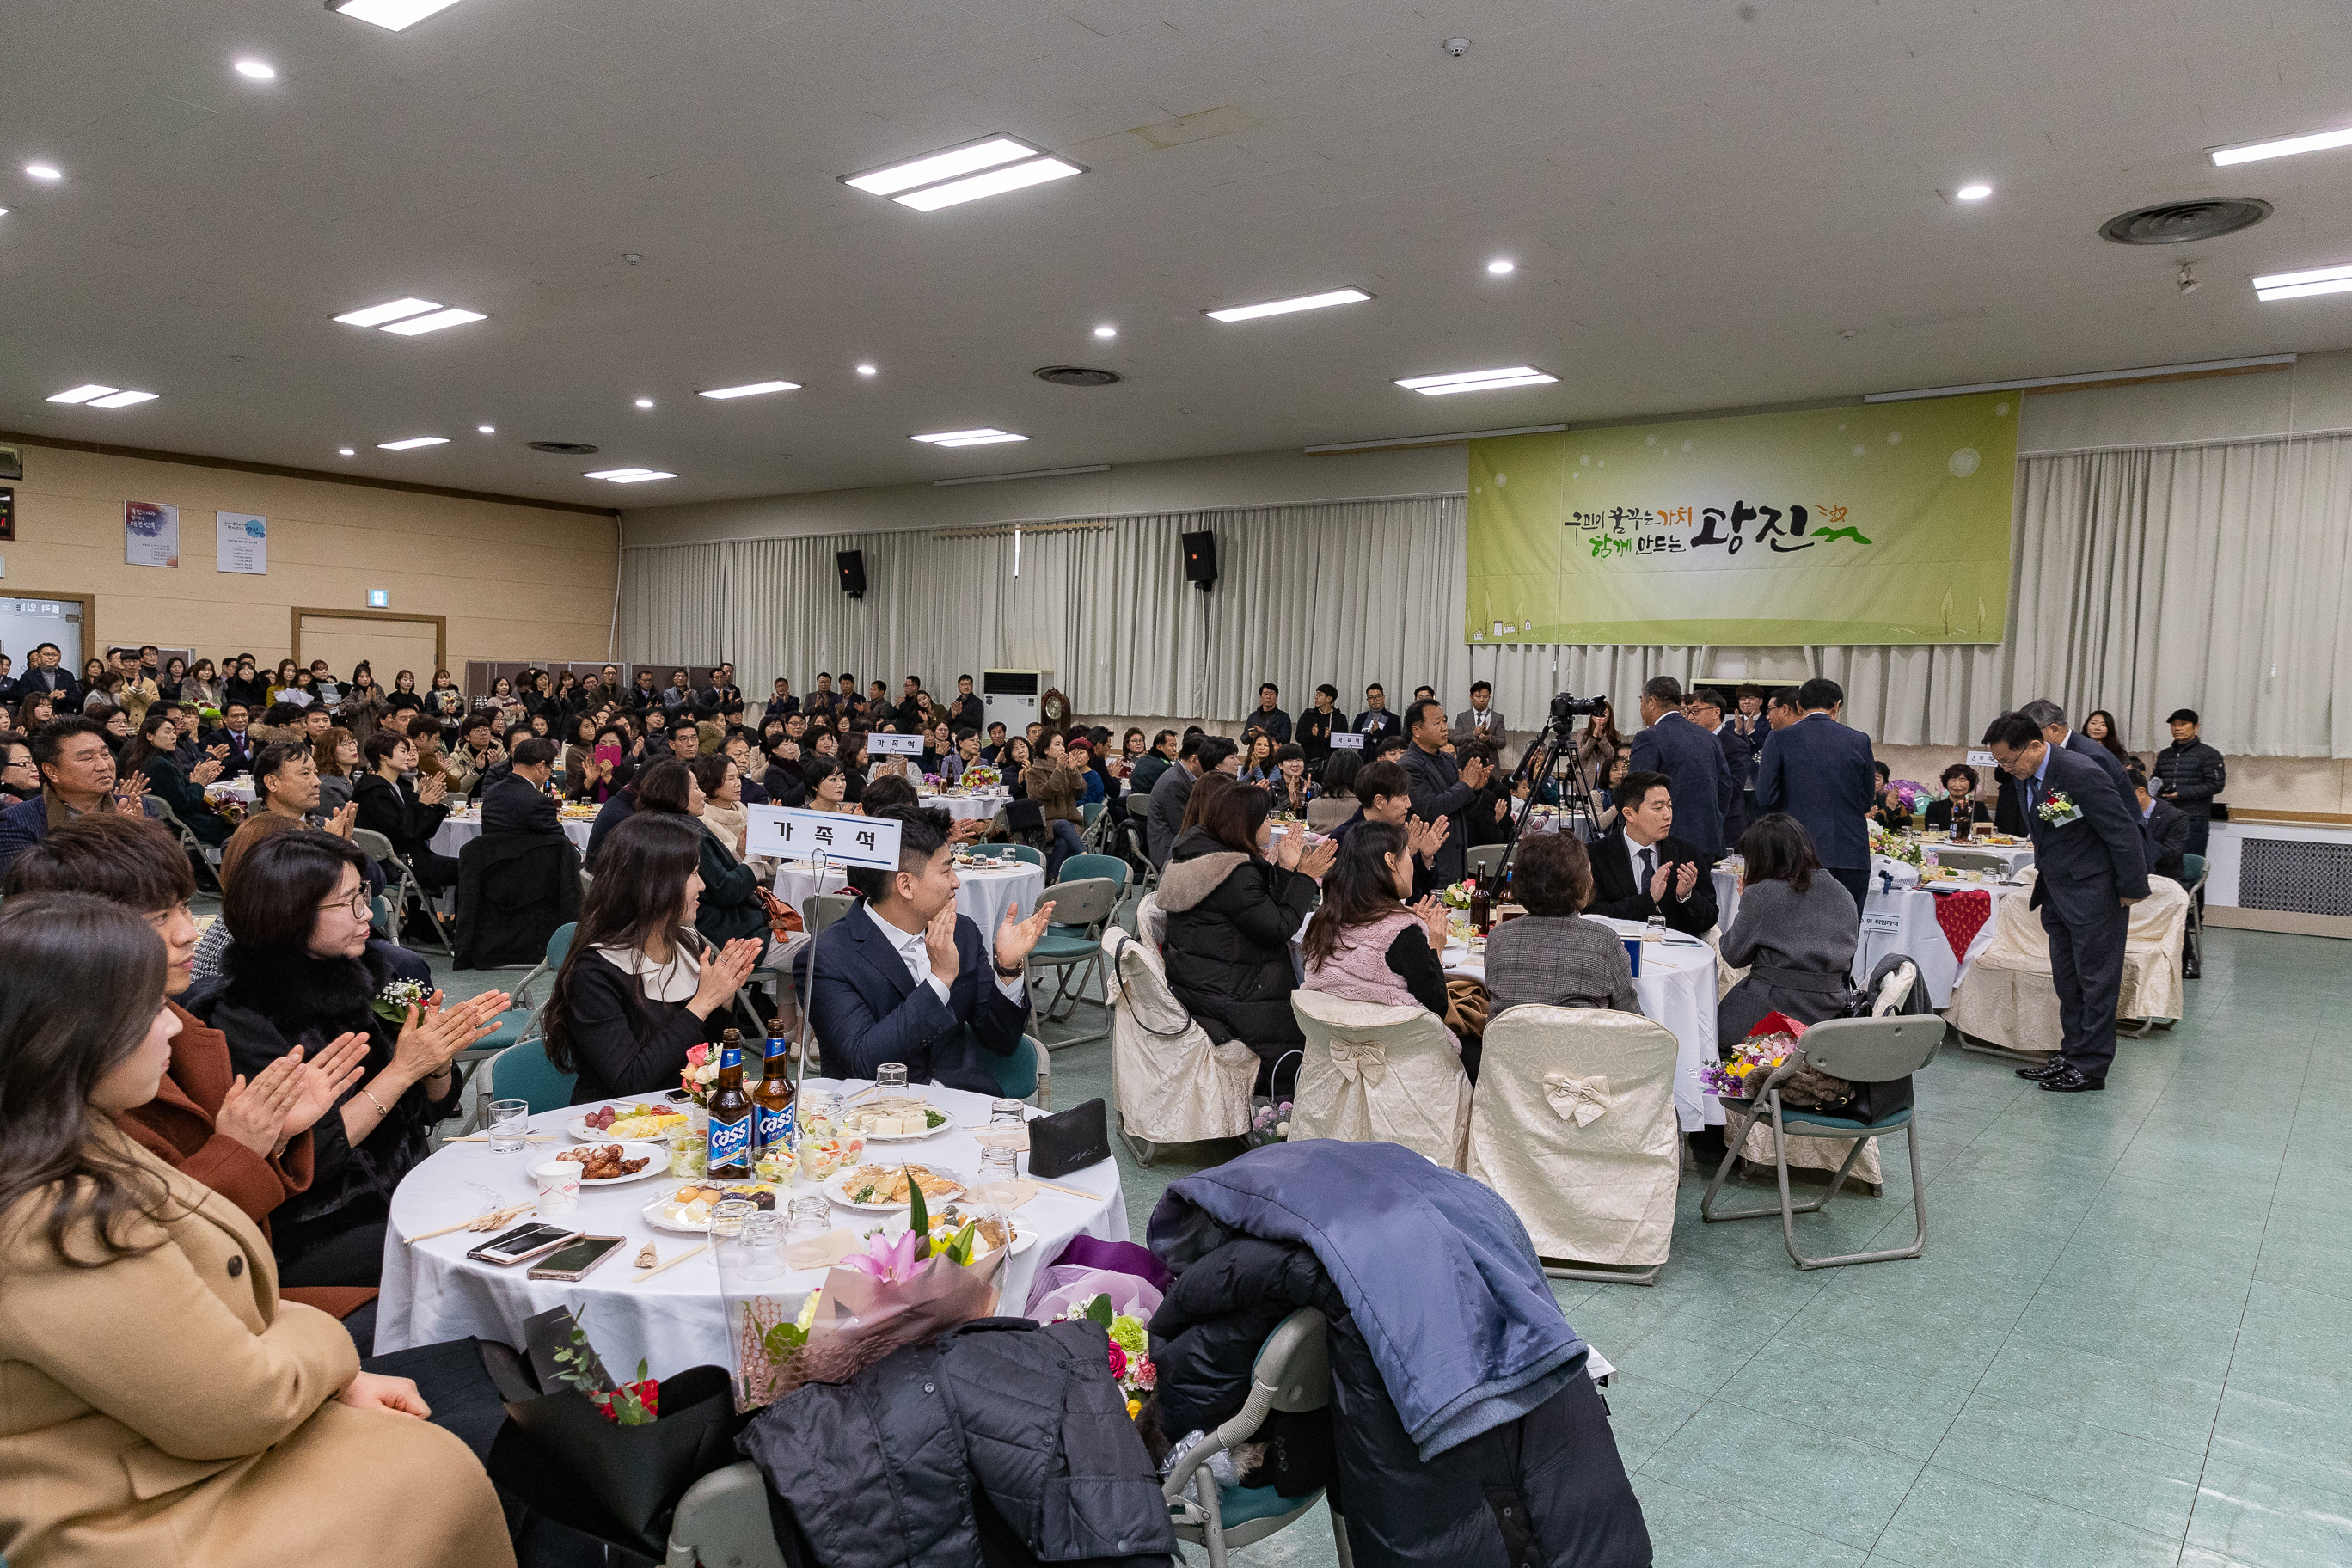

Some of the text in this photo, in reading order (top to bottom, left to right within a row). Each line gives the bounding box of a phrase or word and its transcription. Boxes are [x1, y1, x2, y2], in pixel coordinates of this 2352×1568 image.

[1565, 506, 1693, 546] 구민이 꿈꾸는 가치
[1690, 500, 1815, 554] 광진
[1589, 533, 1686, 563] 함께 만드는
